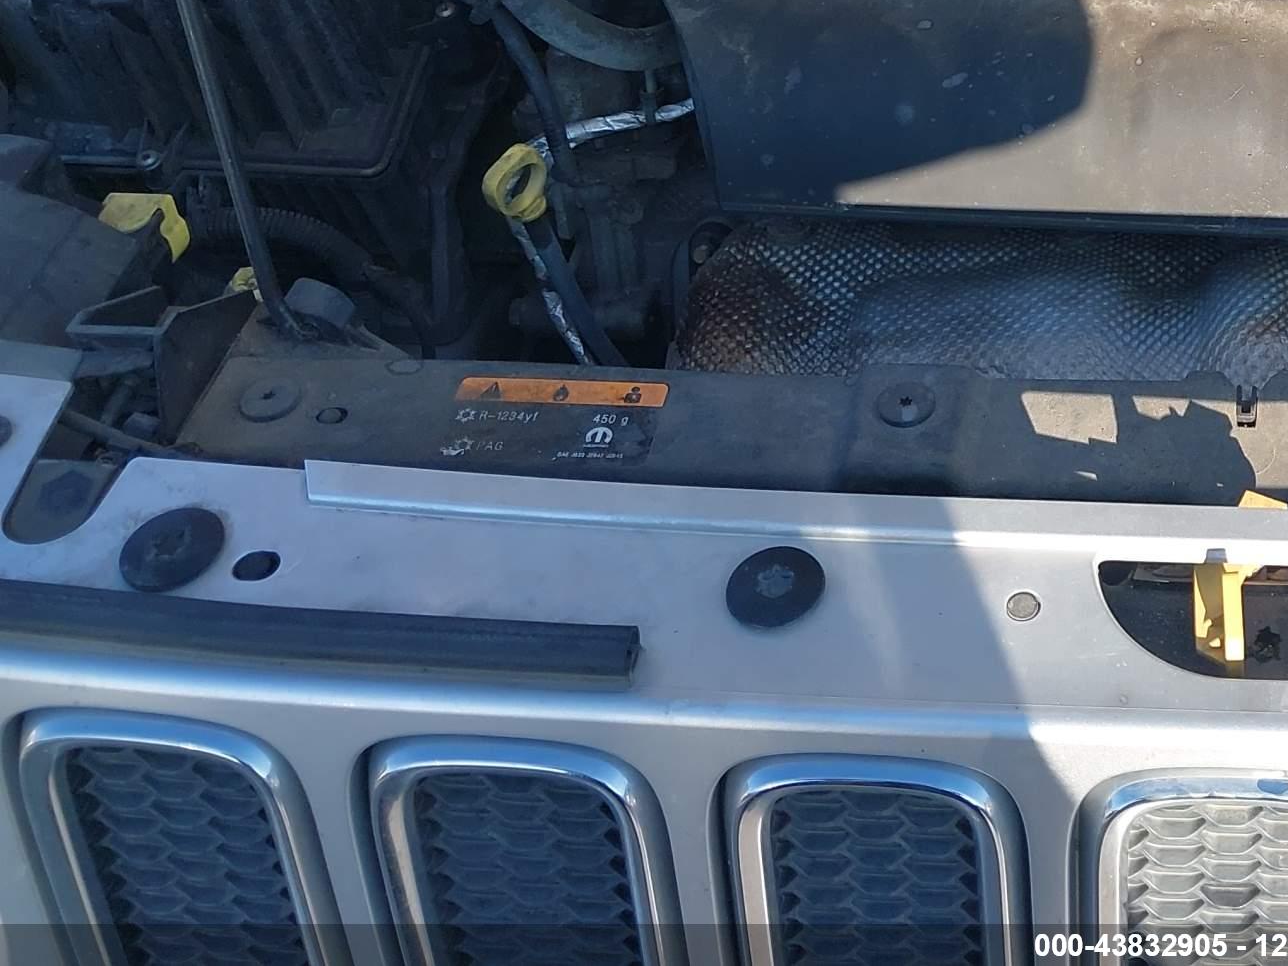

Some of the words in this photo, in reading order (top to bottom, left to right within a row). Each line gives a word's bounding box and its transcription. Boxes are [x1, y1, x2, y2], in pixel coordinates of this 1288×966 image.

[479, 411, 539, 425] R-1234yf
[593, 413, 617, 425] 450
[620, 416, 630, 427] g
